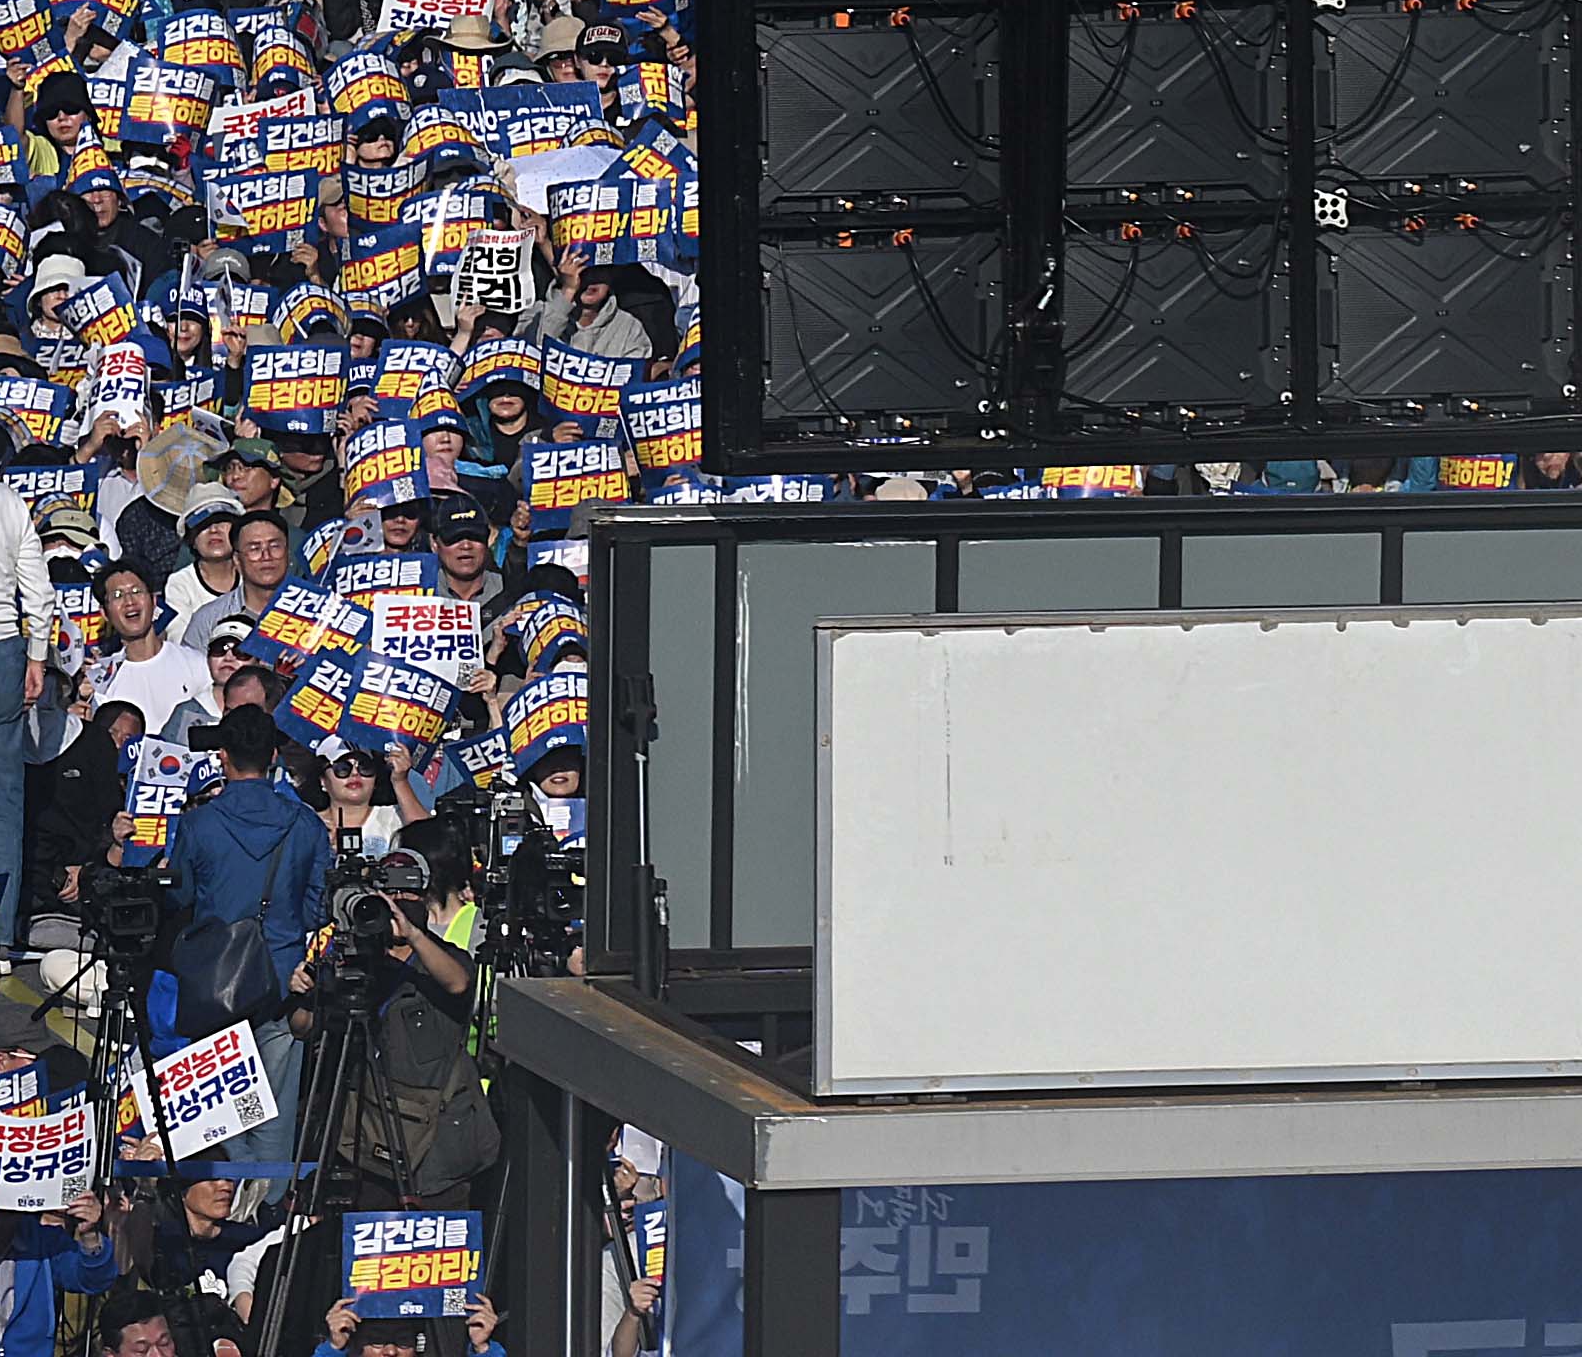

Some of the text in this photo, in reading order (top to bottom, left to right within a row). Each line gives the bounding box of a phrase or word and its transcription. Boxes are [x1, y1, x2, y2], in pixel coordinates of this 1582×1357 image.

[386, 604, 472, 632] 국정농단
[352, 1211, 470, 1259] 김건희를
[351, 1250, 480, 1290] 특검하라!
